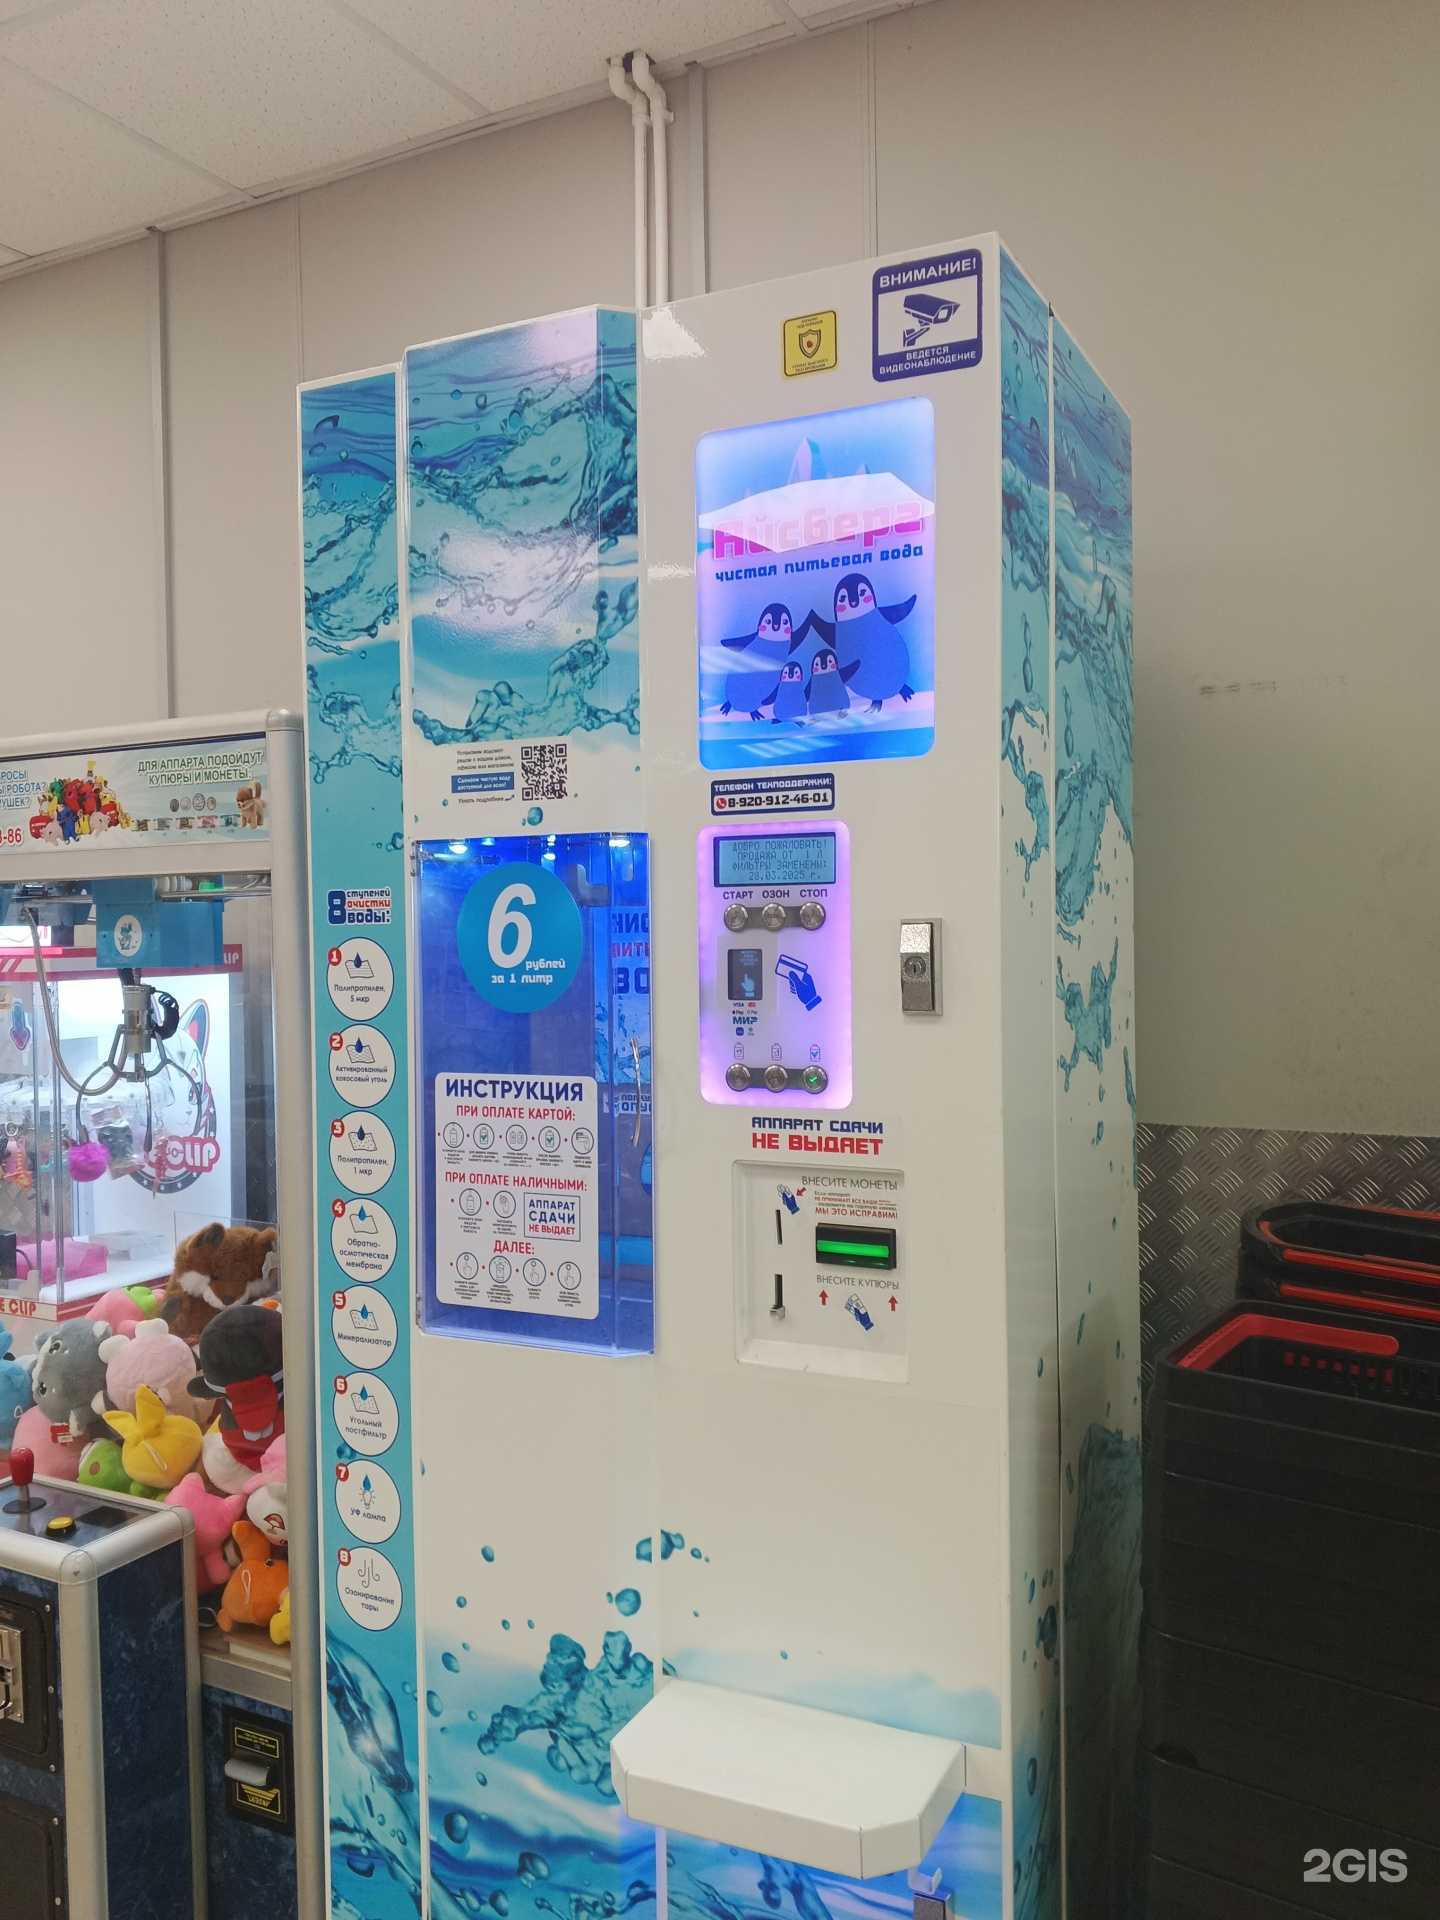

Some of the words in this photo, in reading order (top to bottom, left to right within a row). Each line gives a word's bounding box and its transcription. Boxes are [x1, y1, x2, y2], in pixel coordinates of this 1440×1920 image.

[880, 257, 976, 288] ВНИМАНИЕ!
[906, 346, 949, 361] ВЕДЕТСЯ
[879, 351, 976, 374] ВИДЕОНАБЛЮДЕНИЕ
[716, 564, 777, 582] чистая
[784, 552, 873, 574] питьевая
[880, 544, 923, 561] вода
[138, 760, 158, 772] ДЛЯ
[160, 757, 205, 769] АППАРТА
[207, 752, 262, 766] ПОДОЙДУТ
[149, 773, 192, 785] КУПЮРЫ
[194, 772, 201, 781] И
[204, 769, 248, 780] МОНЕТЫ
[714, 782, 754, 792] ТЕЛЕФОН
[728, 792, 829, 808] 8-920-912-46-01
[732, 842, 760, 853] ДОБРО
[765, 839, 828, 851] ПОЖАЛОВАТЬ!
[737, 850, 777, 862] ПРОДАЖА
[782, 849, 793, 859] ОТ
[732, 861, 772, 871] ФИЛЬТРЫ
[749, 870, 806, 881] 28.03.2025
[723, 891, 754, 900] СТАРТ
[762, 889, 790, 899] ОЗОН
[799, 888, 828, 898] СТОП
[328, 890, 346, 925] 8
[347, 888, 390, 898] ступеней
[347, 899, 391, 908] очистки
[347, 908, 390, 923] воды:
[487, 882, 537, 969] 6
[331, 949, 338, 963] 1
[526, 958, 566, 972] рублей
[491, 974, 505, 984] за
[510, 974, 517, 984] 1
[521, 974, 553, 985] литр
[732, 1016, 758, 1025] МИР
[331, 1035, 341, 1048] 2
[446, 1078, 583, 1104] ИНСТРУКЦИЯ
[456, 1105, 478, 1117] ПРИ
[482, 1105, 525, 1119] ОПЛАТЕ
[528, 1107, 576, 1121] КАРТОЙ:
[333, 1122, 343, 1135] 3
[752, 1116, 823, 1131] АППАРАТ
[829, 1120, 883, 1134] СДАЧИ
[752, 1132, 780, 1149] НЕ
[788, 1134, 883, 1156] ВЫДАЕТ
[359, 1168, 372, 1176] мкр
[445, 1171, 466, 1183] ПРИ
[469, 1173, 509, 1186] ОПЛАТЕ
[512, 1175, 587, 1191] НАЛИЧНЫМИ:
[801, 1176, 847, 1188] ВНЕСИТЕ
[850, 1178, 898, 1190] МОНЕТЫ
[334, 1202, 343, 1214] 4
[528, 1199, 576, 1211] АППАРАТ
[528, 1211, 576, 1224] СДАЧИ
[815, 1207, 829, 1215] МЫ
[831, 1208, 848, 1216] ЭТО
[849, 1209, 898, 1220] ИСПРАВИМ!
[528, 1224, 540, 1233] НЕ
[541, 1225, 575, 1236] ВЫДАЕТ
[493, 1239, 535, 1255] ДАЛЕЕ:
[817, 1274, 855, 1287] ВНЕСИТЕ
[858, 1277, 899, 1290] КУПЮРЫ
[334, 1293, 343, 1306] 5
[338, 1333, 392, 1347] Минерализатор
[336, 1378, 345, 1391] 6
[337, 1466, 346, 1479] 7
[339, 1552, 349, 1564] 8
